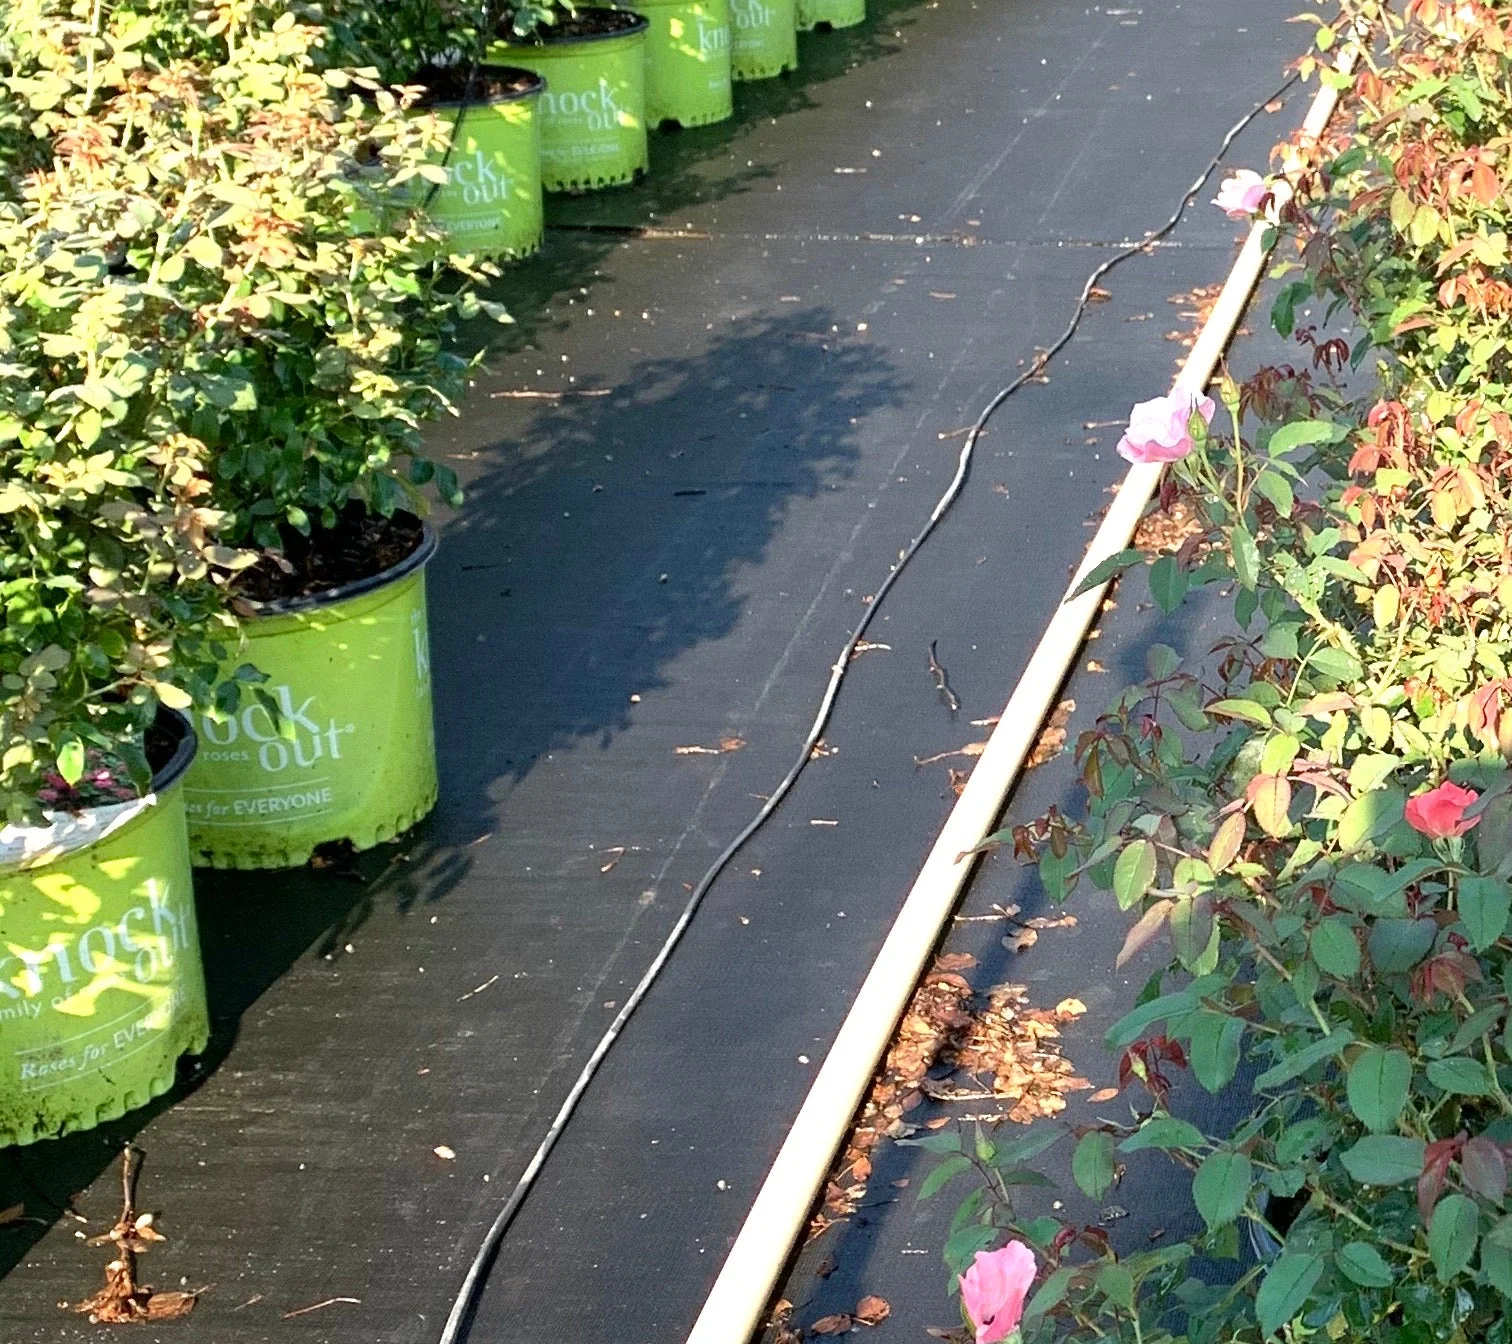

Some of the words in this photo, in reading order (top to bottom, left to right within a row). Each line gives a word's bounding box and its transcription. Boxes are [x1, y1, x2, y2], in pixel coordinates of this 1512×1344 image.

[538, 78, 618, 115] nock
[463, 173, 510, 205] out
[202, 685, 321, 745] ock
[203, 750, 250, 762] roses
[259, 717, 344, 773] out
[206, 798, 229, 819] for
[233, 787, 333, 816] EVERYONE
[0, 1000, 42, 1019] mily
[21, 1058, 75, 1081] Roses
[78, 1043, 109, 1071] for
